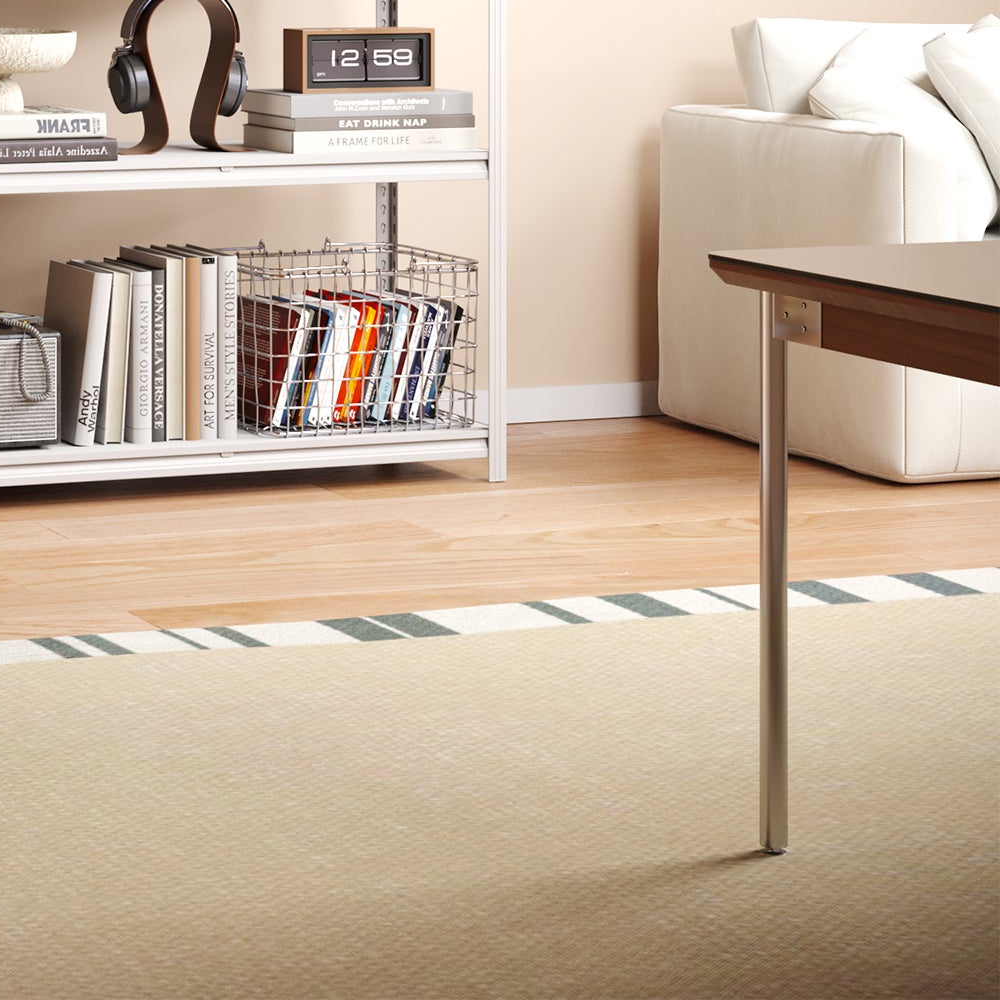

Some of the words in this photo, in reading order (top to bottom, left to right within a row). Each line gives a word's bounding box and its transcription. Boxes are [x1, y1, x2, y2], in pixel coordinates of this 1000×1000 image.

[331, 49, 359, 67] 12
[373, 48, 412, 67] 59
[328, 138, 335, 146] A
[336, 137, 369, 146] FRAME
[371, 136, 389, 145] FOR
[391, 136, 410, 145] LIFE
[338, 120, 360, 128] EAT
[364, 119, 400, 127] DRINK
[403, 118, 427, 127] NAP
[225, 270, 235, 329] STORIES
[139, 300, 149, 355] ARMANI
[154, 284, 164, 366] DONATELLA
[204, 332, 215, 381] SURVIVAL
[225, 331, 235, 377] STYLE
[78, 390, 92, 427] Andy
[88, 385, 100, 433] Warhol
[139, 359, 149, 417] GIORGIO
[154, 366, 164, 430] VERSACE
[204, 388, 215, 409] FOR
[225, 380, 235, 421] MEN'S
[204, 411, 215, 429] ART
